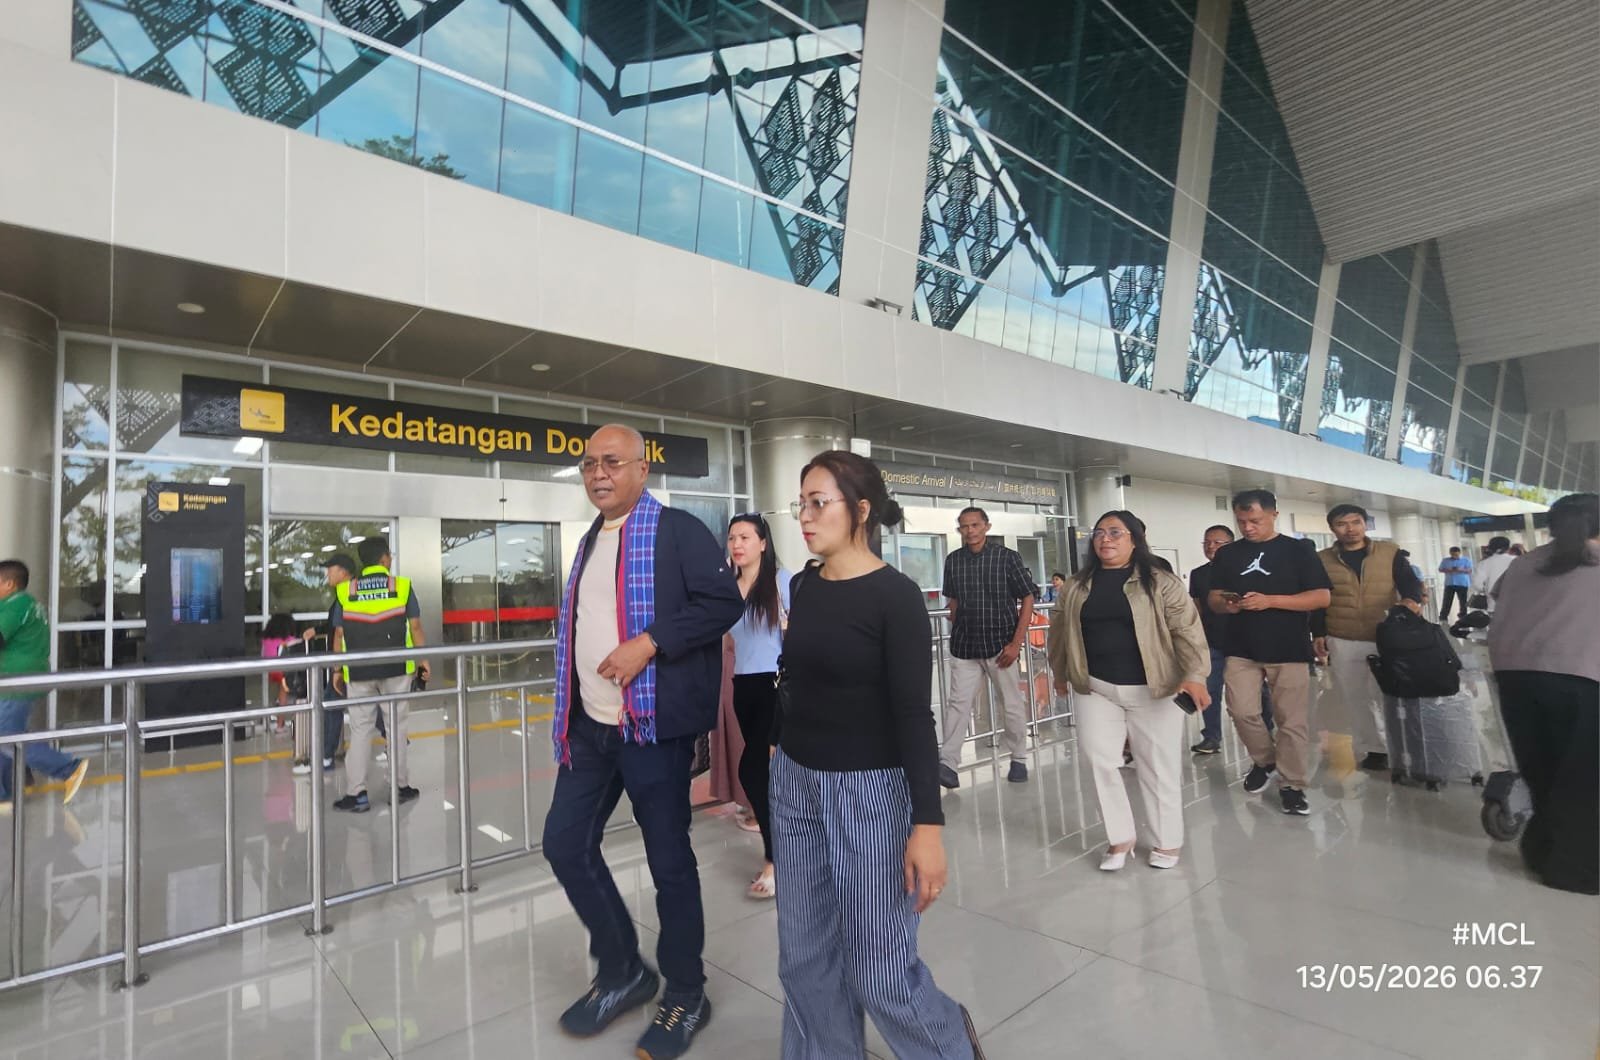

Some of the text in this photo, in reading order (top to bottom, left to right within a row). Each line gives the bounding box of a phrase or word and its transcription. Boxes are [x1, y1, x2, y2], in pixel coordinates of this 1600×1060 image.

[330, 403, 665, 463] Kedatangan Doik
[881, 470, 920, 485] Domestic
[921, 474, 946, 488] Arrival
[183, 494, 227, 504] Kedatangan
